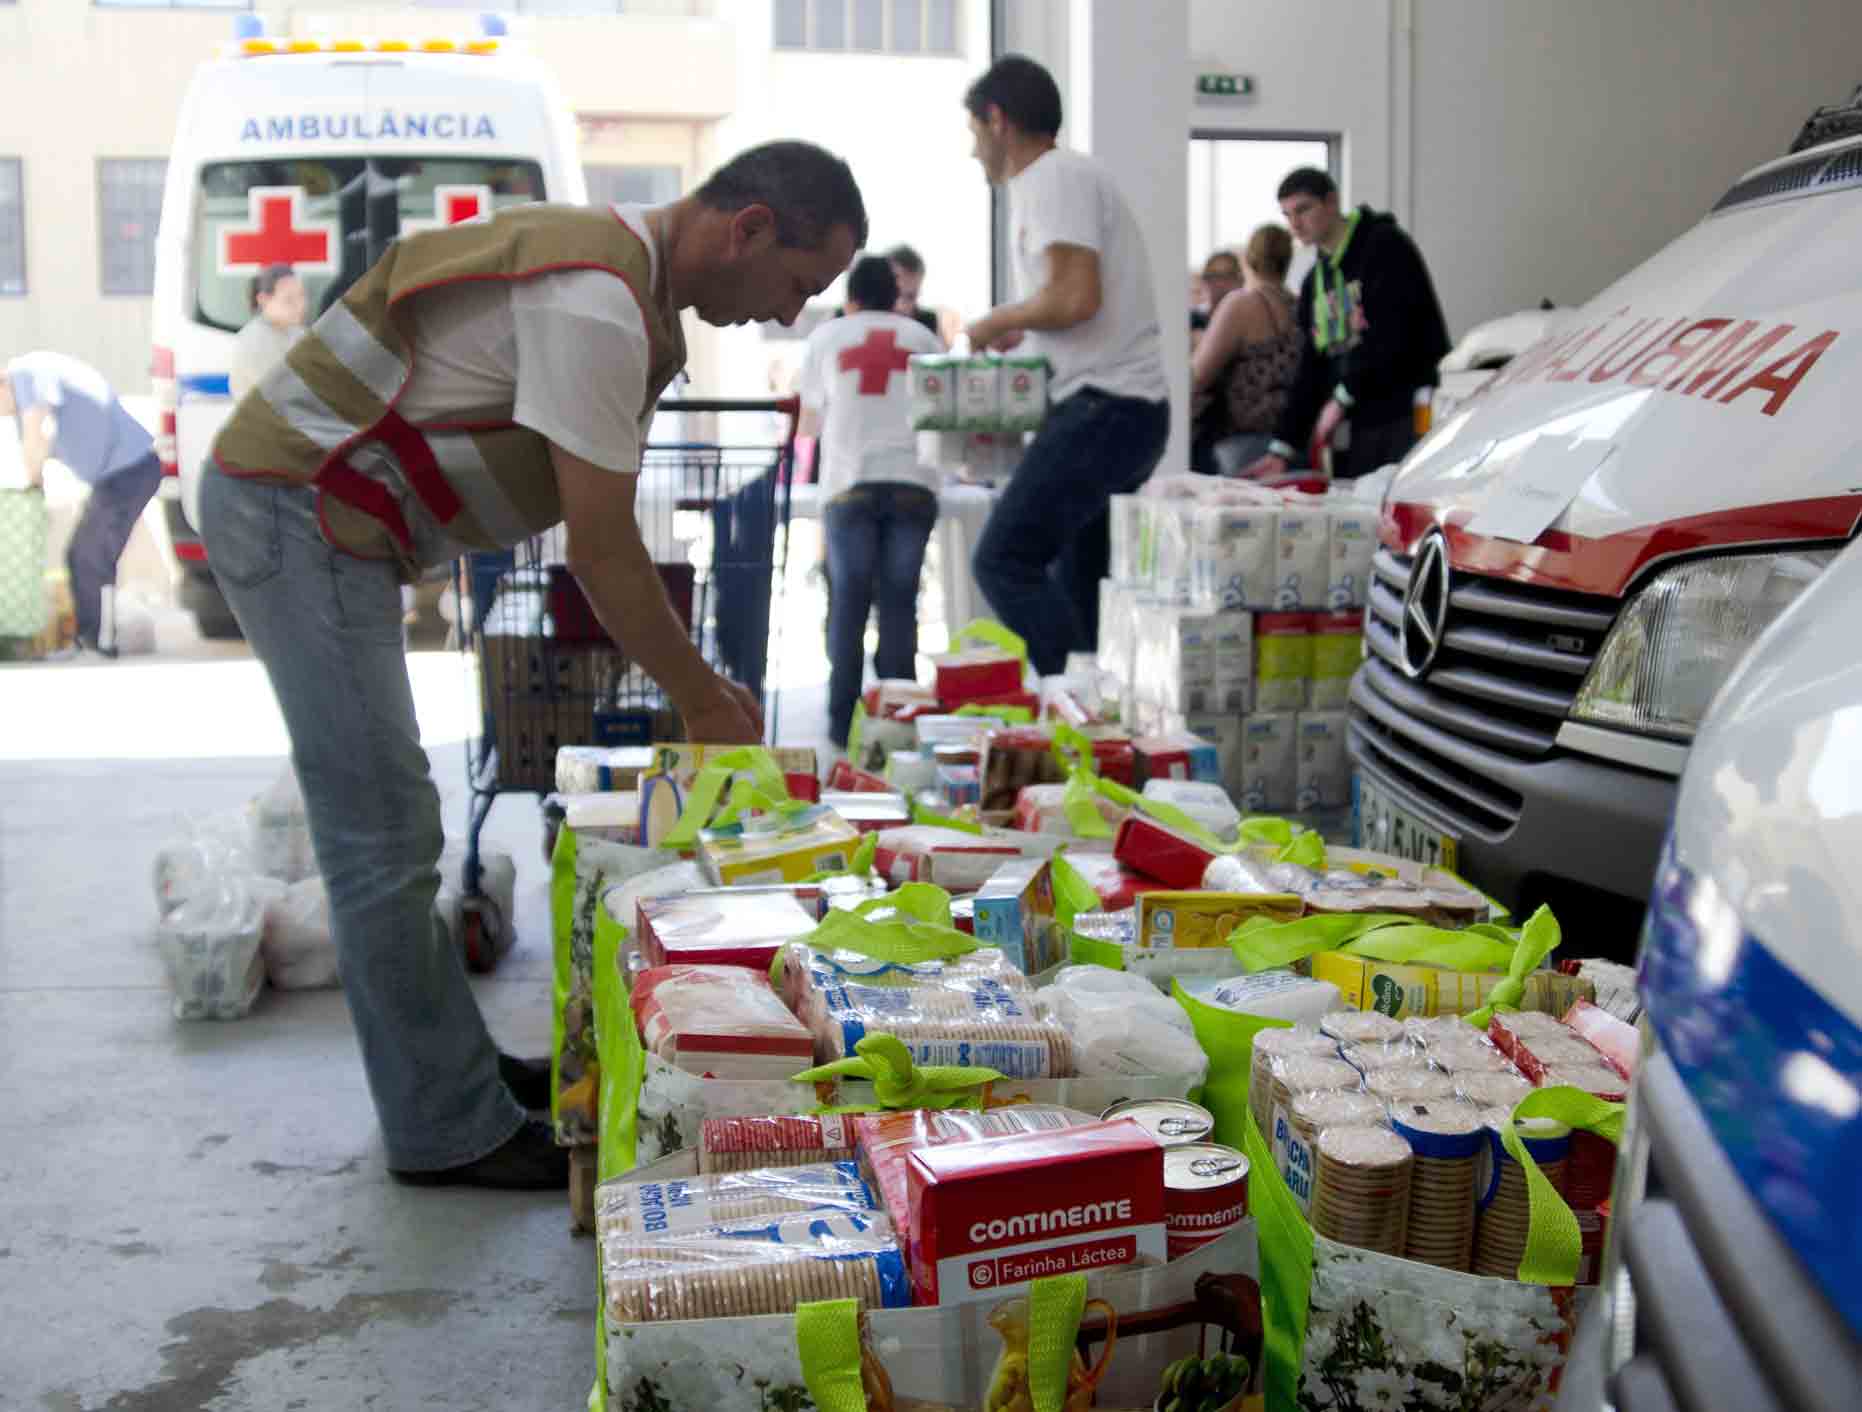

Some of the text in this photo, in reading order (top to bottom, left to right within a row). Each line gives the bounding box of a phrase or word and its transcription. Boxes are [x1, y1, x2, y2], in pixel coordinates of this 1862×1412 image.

[241, 108, 497, 141] AMBULÂNCIA
[969, 1199, 1132, 1243] CONTINENTE
[1003, 1255, 1067, 1280] Farinha
[1072, 1246, 1127, 1267] Láctea
